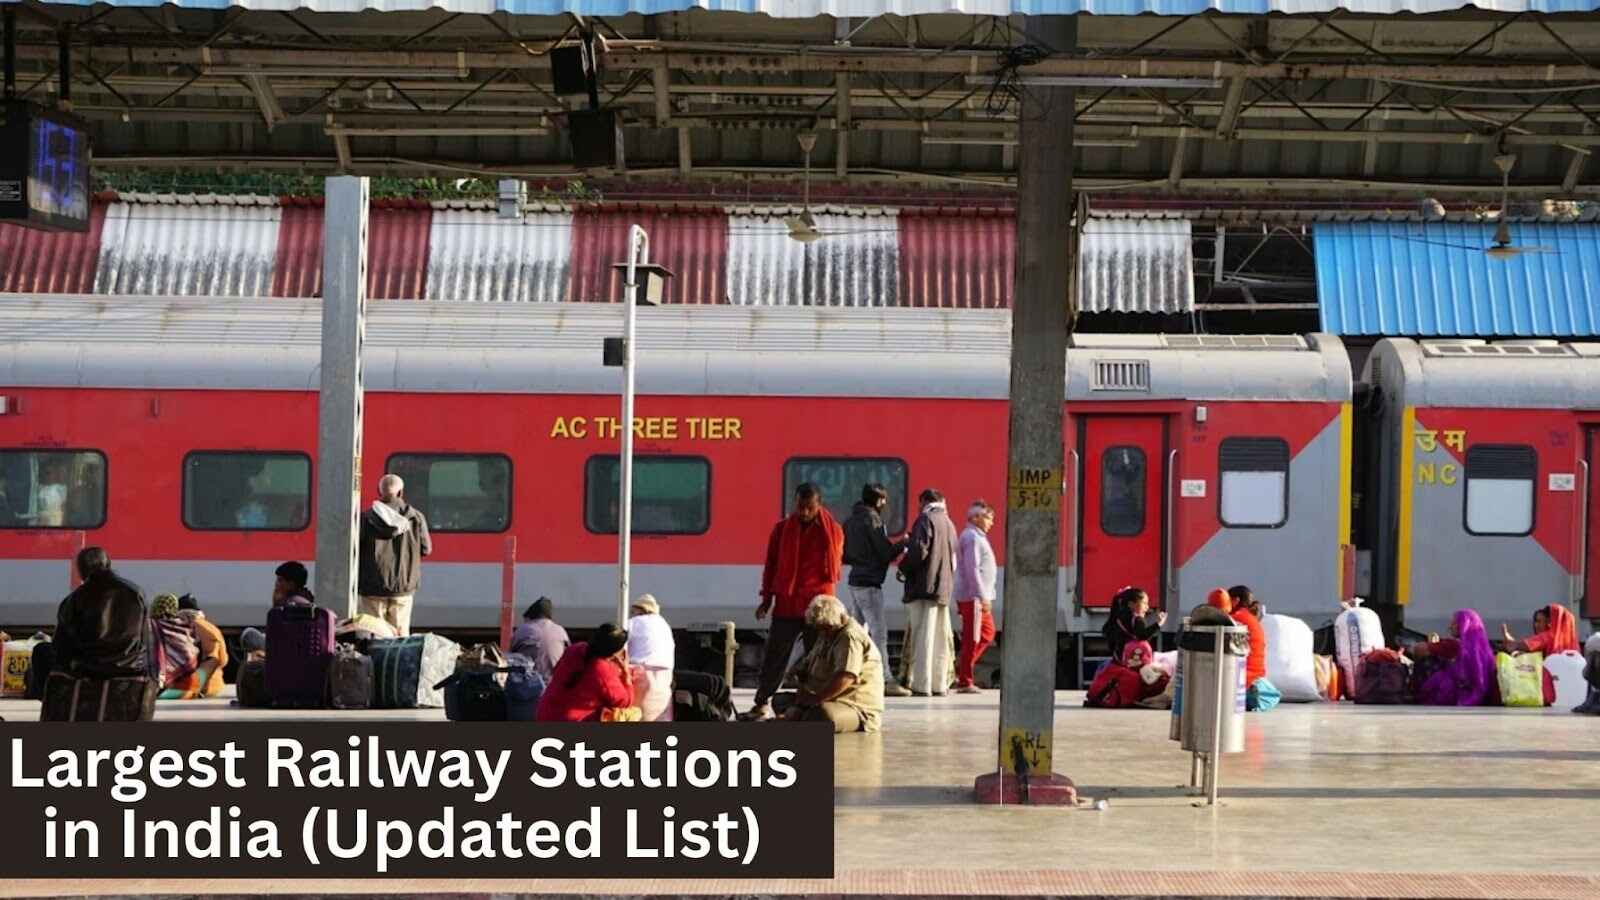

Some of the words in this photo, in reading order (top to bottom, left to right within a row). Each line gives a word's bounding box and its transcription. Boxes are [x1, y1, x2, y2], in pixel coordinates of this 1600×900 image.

[551, 416, 587, 439] AC
[594, 416, 678, 439] THREE
[685, 417, 742, 440] TIER
[1019, 468, 1051, 485] IMP
